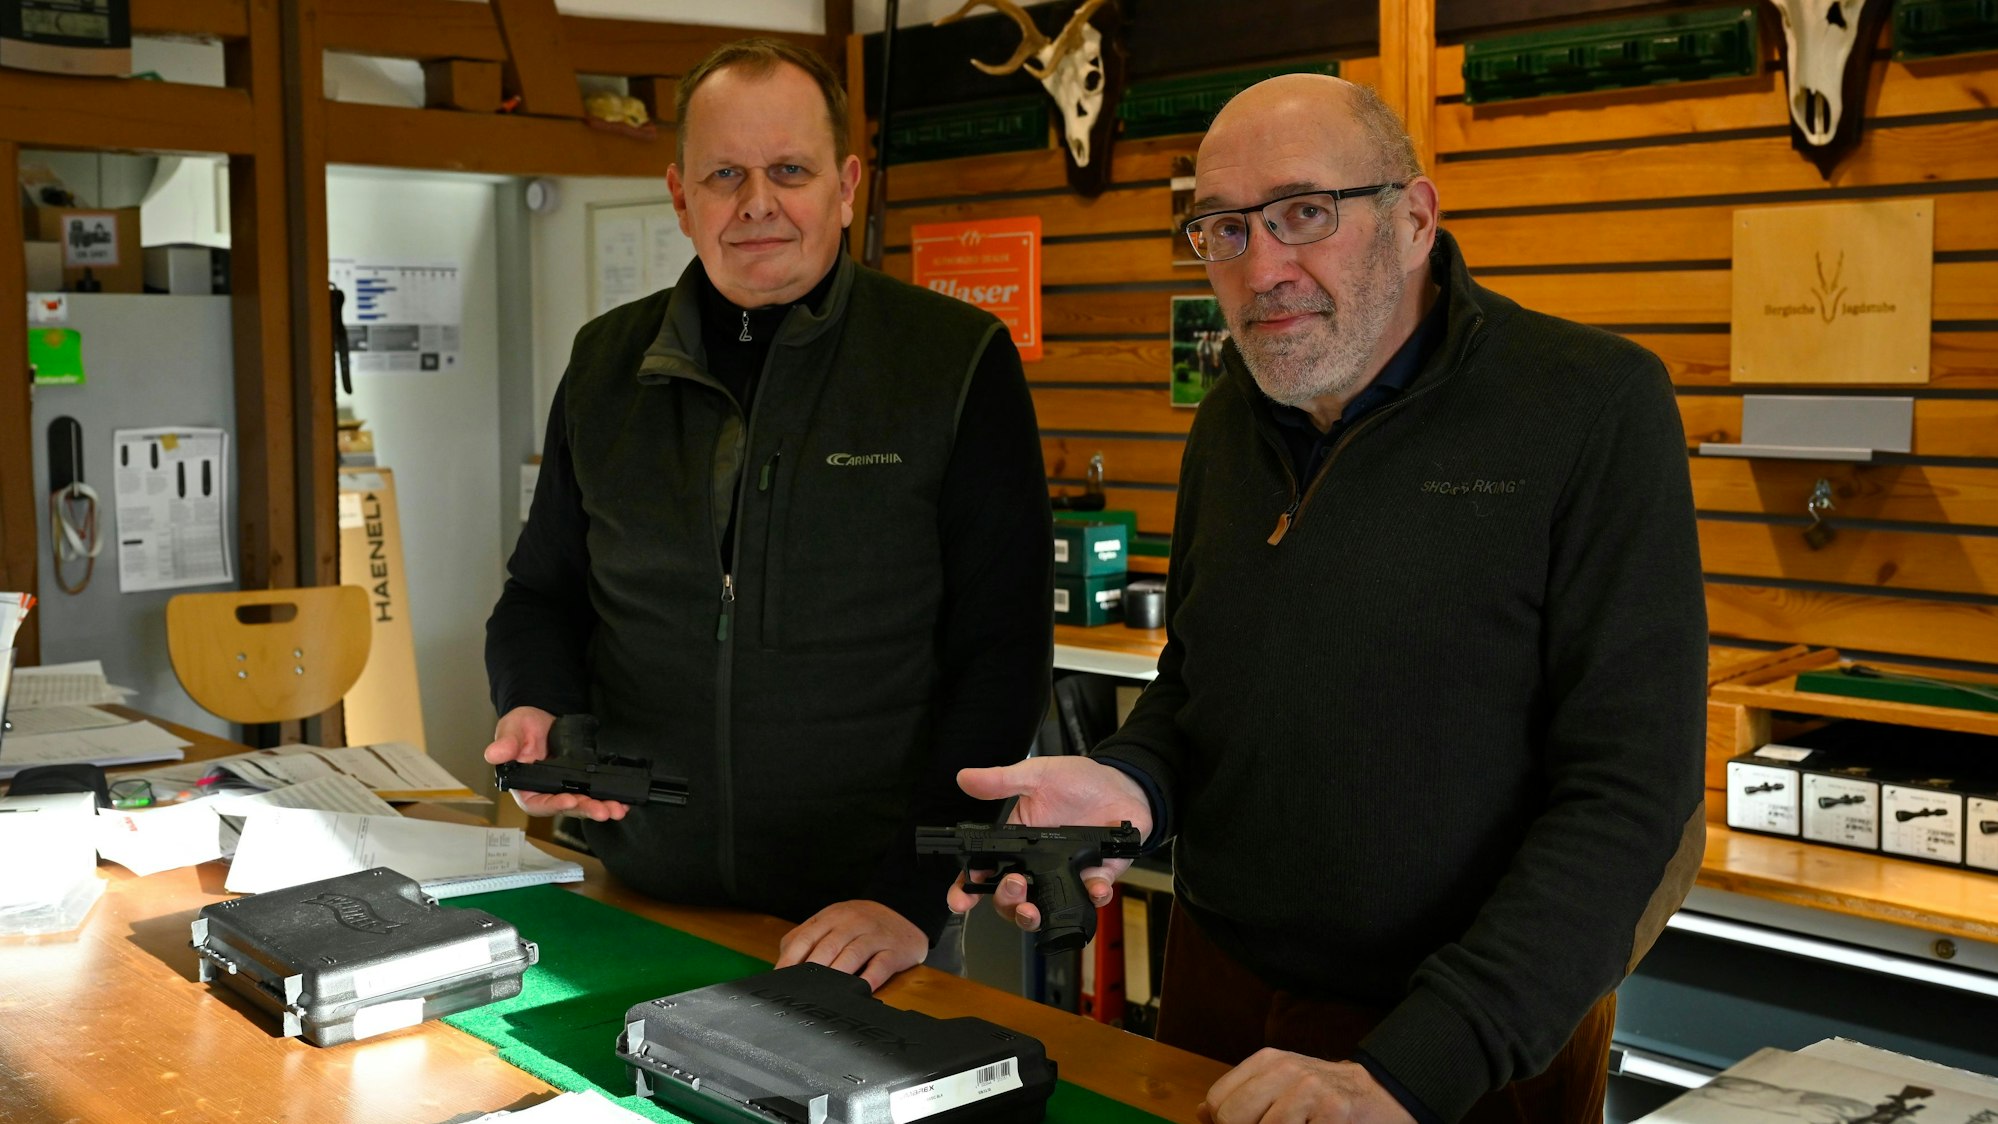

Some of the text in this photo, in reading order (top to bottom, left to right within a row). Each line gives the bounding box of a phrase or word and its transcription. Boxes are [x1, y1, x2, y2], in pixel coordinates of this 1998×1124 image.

[1763, 302, 1897, 318] Bergische Jagdstube
[826, 452, 903, 466] CARINTHIA
[1421, 479, 1517, 495] SHORKING
[365, 503, 394, 622] HAENEL
[900, 1084, 935, 1101] AREX
